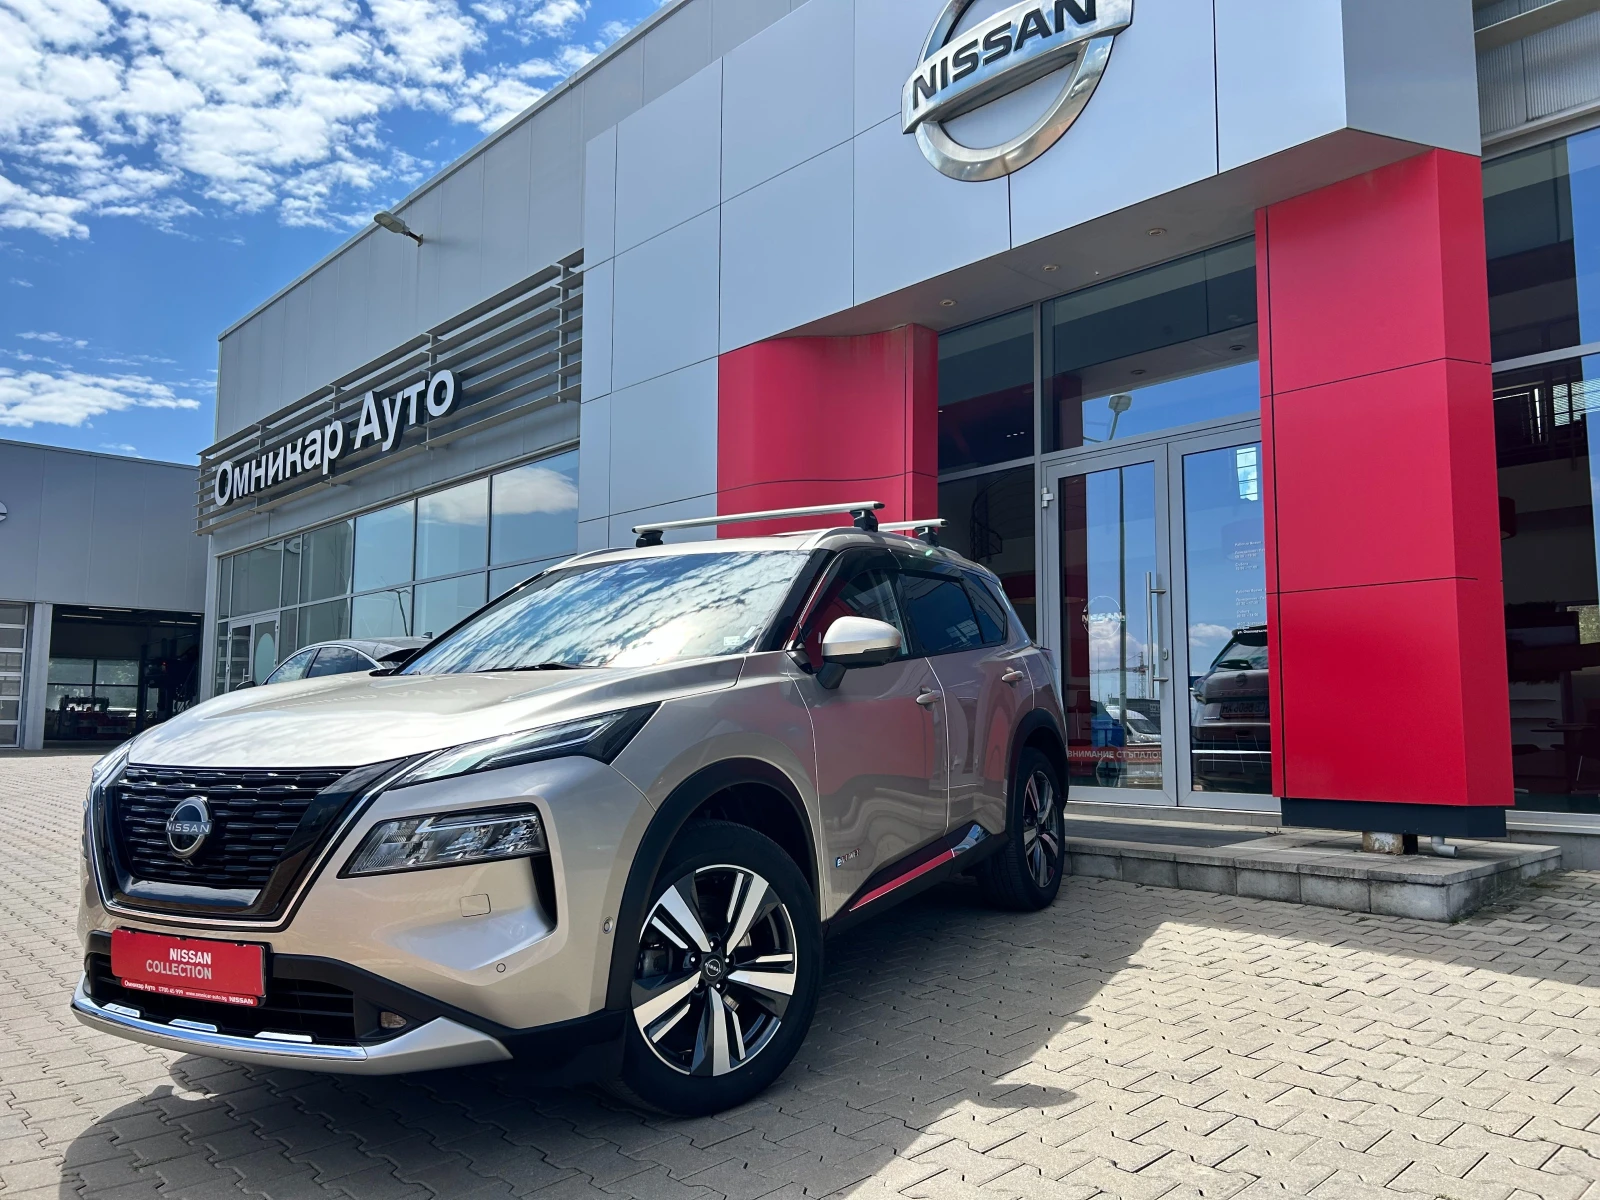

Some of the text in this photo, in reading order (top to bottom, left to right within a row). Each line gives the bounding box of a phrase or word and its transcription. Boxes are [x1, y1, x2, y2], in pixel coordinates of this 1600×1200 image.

[912, 0, 1097, 110] NISSAN
[214, 369, 456, 507] Омникар Ауто
[1068, 750, 1114, 759] ВНИМАНИЕ
[167, 823, 210, 833] NISSAN
[170, 948, 211, 964] NISSAN
[146, 959, 212, 979] COLLECTION
[228, 996, 253, 1004] NISSAN
